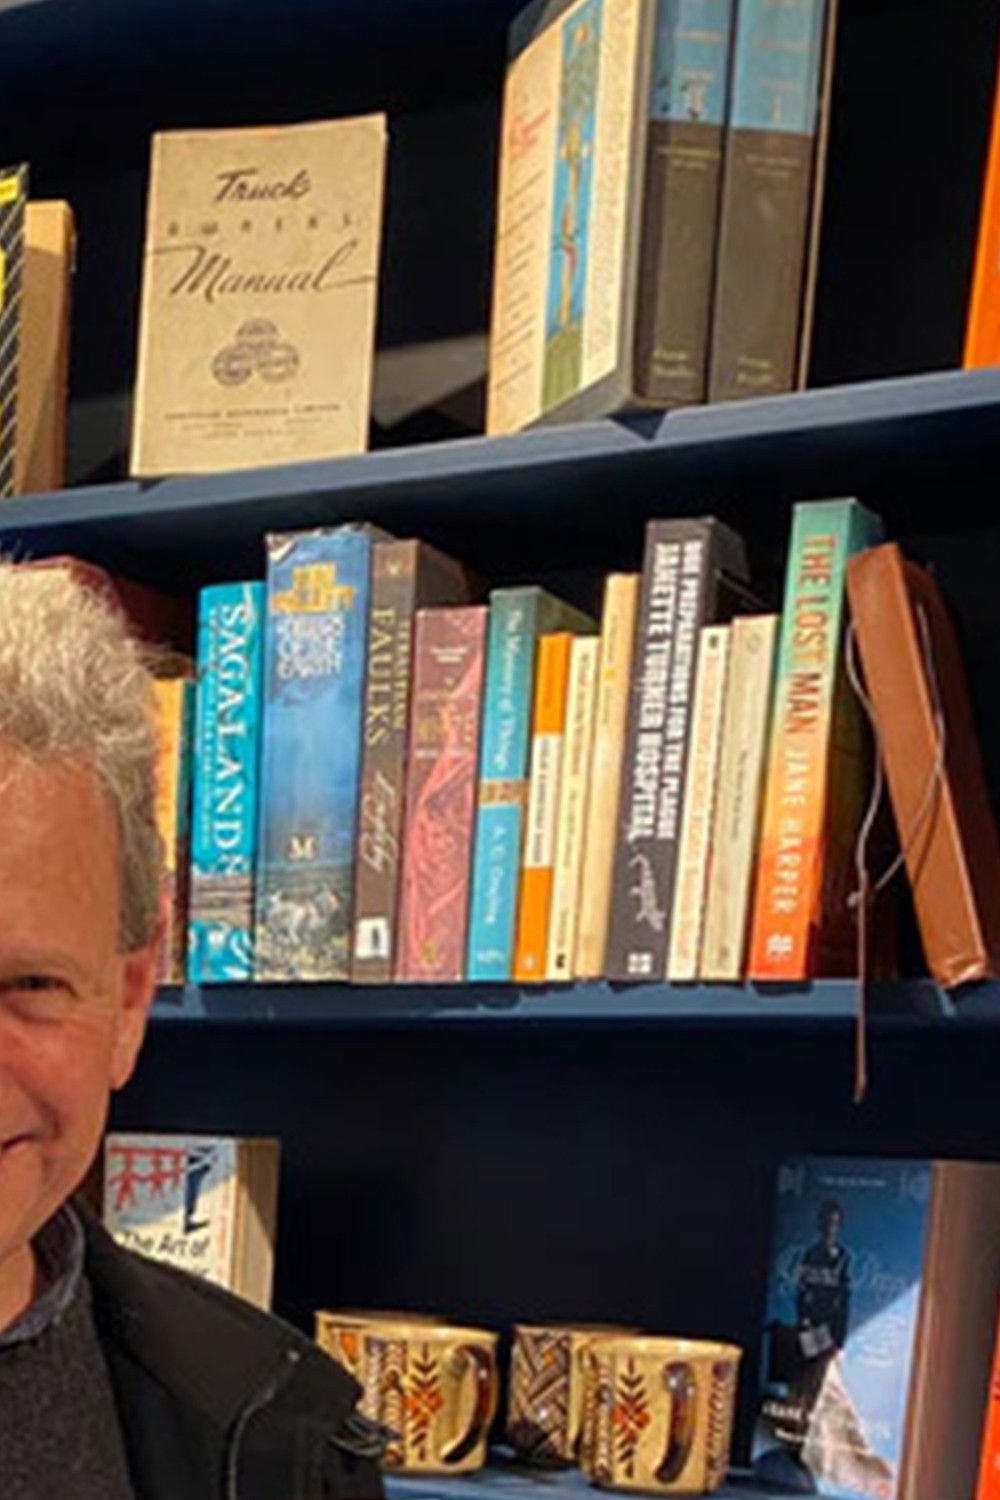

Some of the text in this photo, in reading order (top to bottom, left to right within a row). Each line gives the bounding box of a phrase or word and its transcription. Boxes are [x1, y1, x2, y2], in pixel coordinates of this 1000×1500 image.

[214, 167, 311, 201] Truck
[365, 607, 396, 747] FAULKS
[784, 534, 837, 736] THE LOST MAN
[770, 747, 811, 914] JANE HARPER
